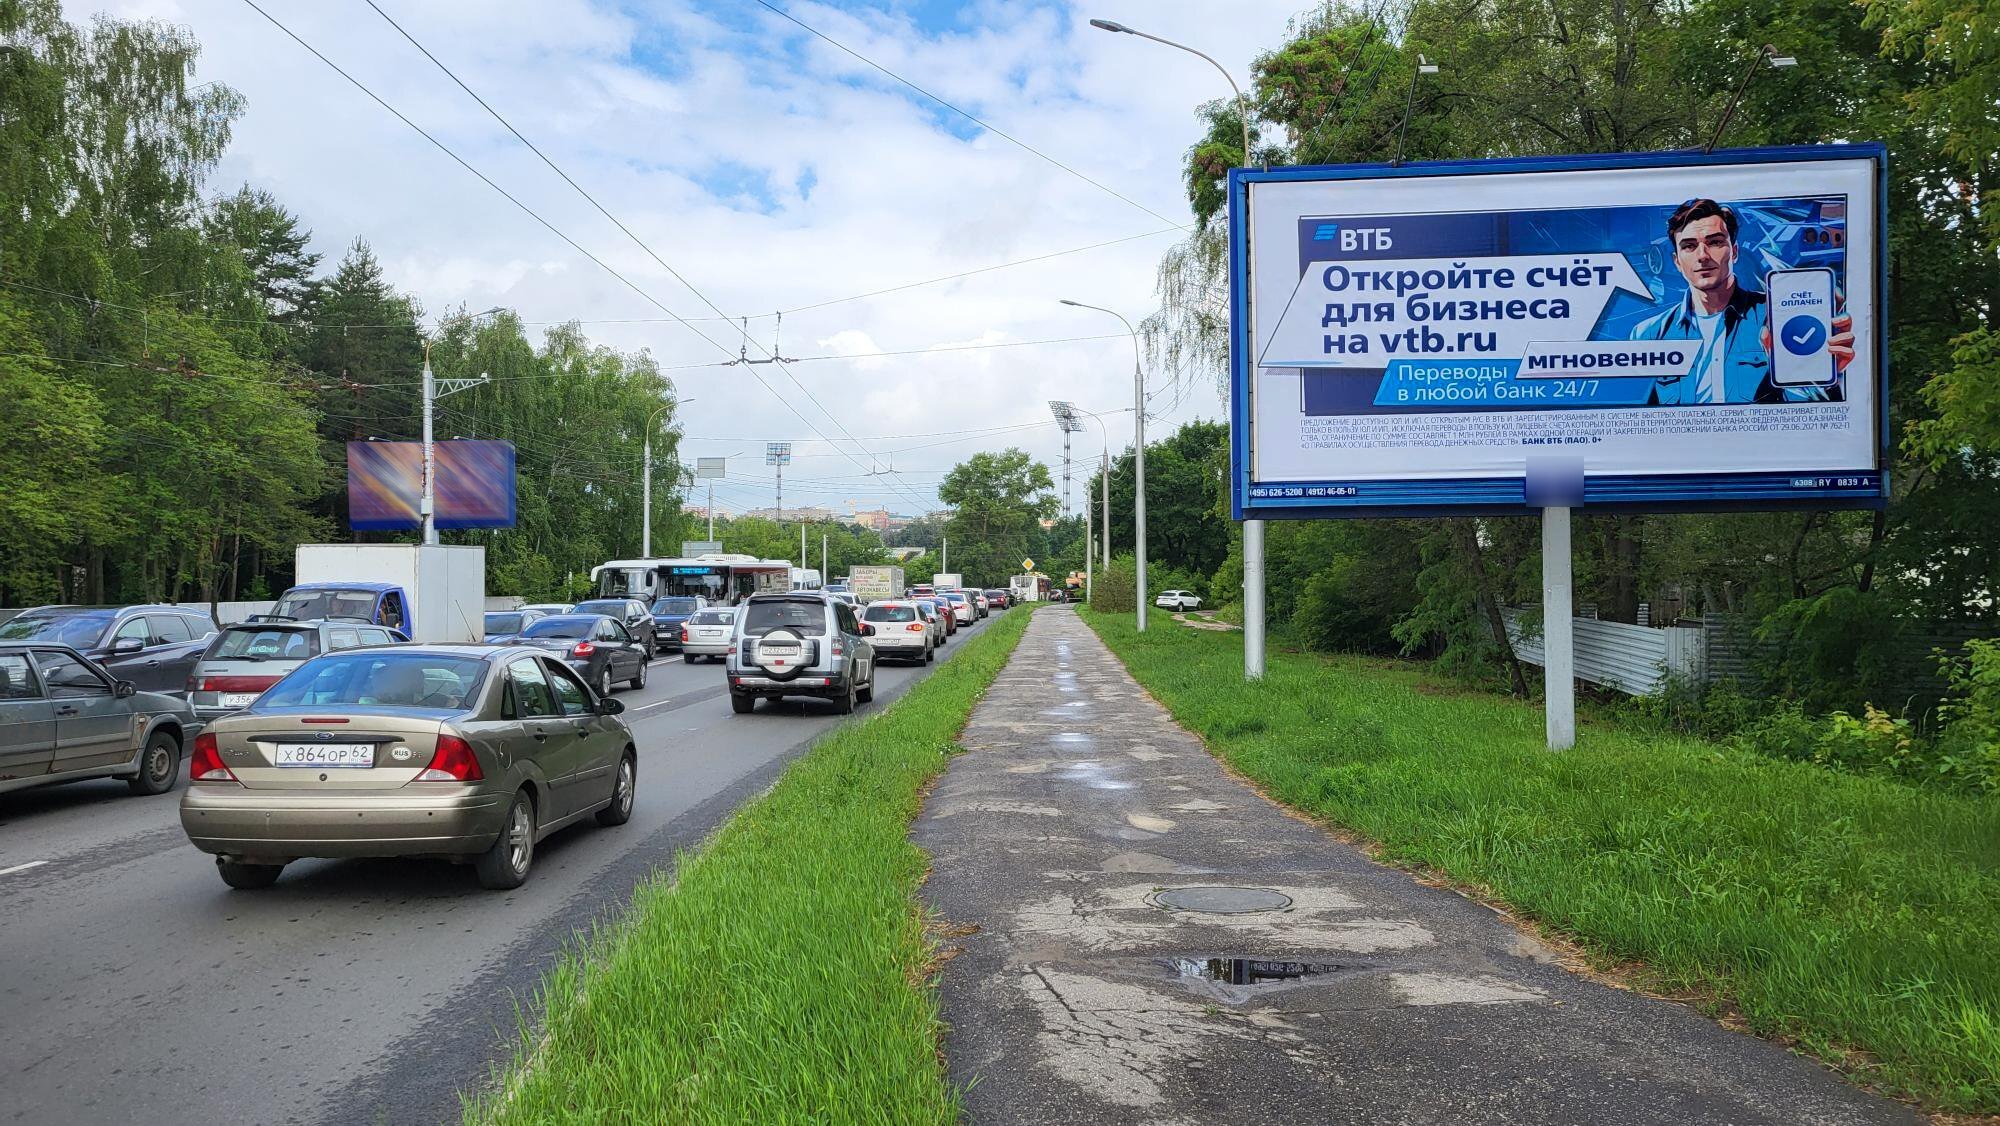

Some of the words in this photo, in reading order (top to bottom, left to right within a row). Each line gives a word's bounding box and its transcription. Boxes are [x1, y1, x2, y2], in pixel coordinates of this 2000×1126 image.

[1340, 227, 1393, 251] ВТБ
[1323, 262, 1515, 297] Откройте
[1526, 259, 1613, 286] счёт
[1321, 302, 1395, 327] для
[1406, 293, 1570, 321] бизнеса
[1323, 334, 1369, 353] на
[1379, 325, 1497, 353] vtb.ru
[1528, 351, 1684, 369] мгновенно
[1399, 365, 1507, 385] Переводы
[1398, 389, 1408, 401] в
[1414, 382, 1487, 401] любой
[1494, 381, 1547, 399] банк
[1553, 380, 1599, 398] 24/7
[1522, 437, 1545, 445] БАНК
[1547, 437, 1563, 445] ВТБ
